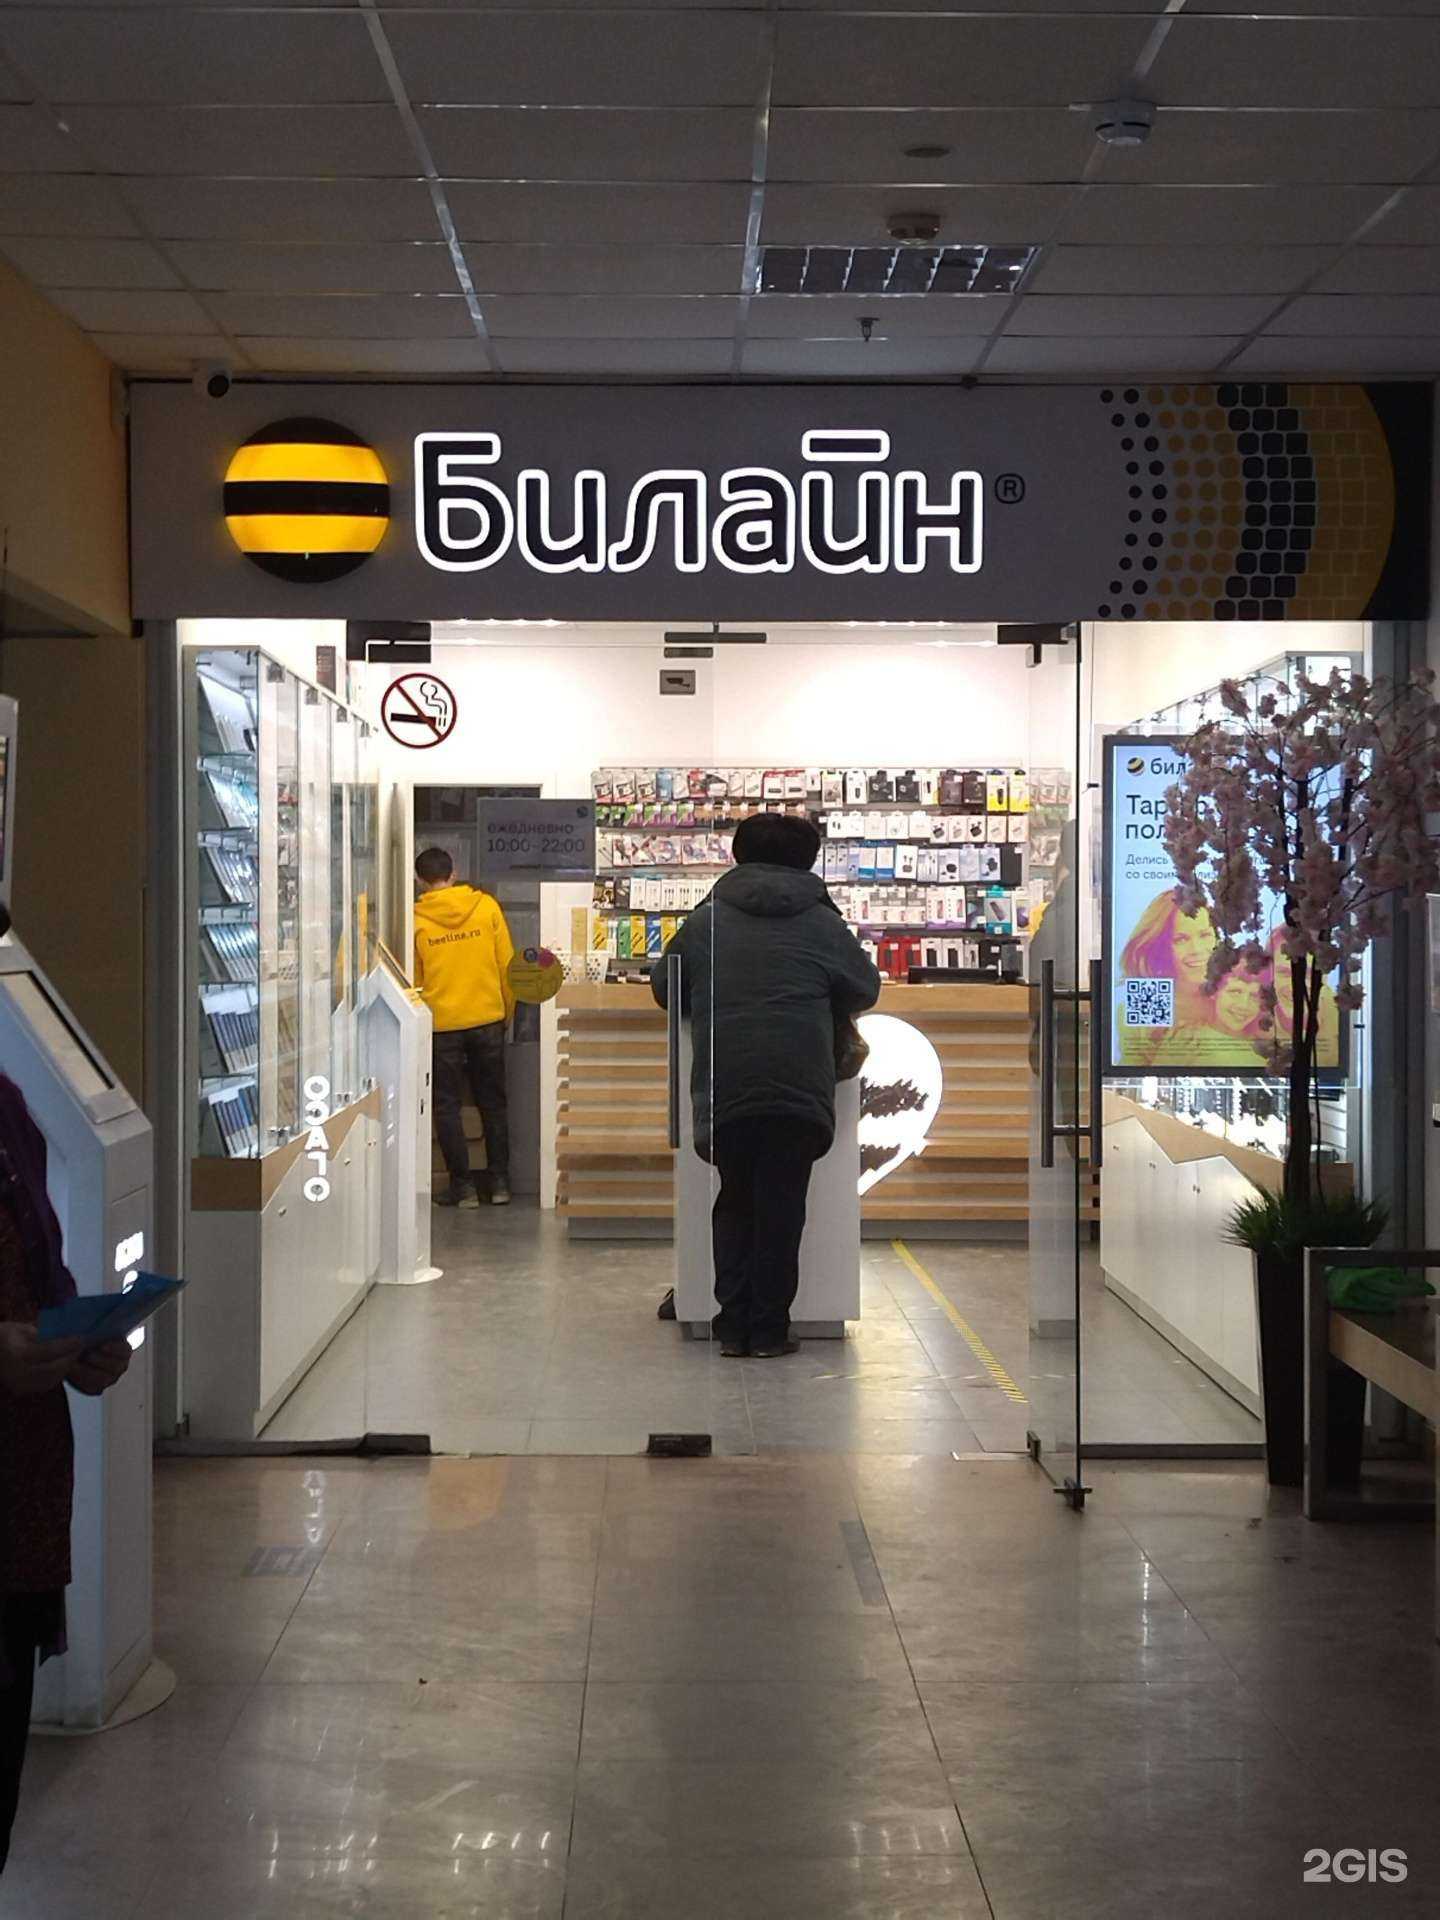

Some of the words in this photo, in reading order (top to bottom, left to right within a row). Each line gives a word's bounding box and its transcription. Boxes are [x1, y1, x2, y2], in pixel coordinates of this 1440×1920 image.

[414, 429, 983, 574] Билайн
[487, 823, 574, 835] ежедневно
[1125, 853, 1168, 865] Делись
[1126, 871, 1140, 879] со
[428, 929, 481, 947] beeline.ru
